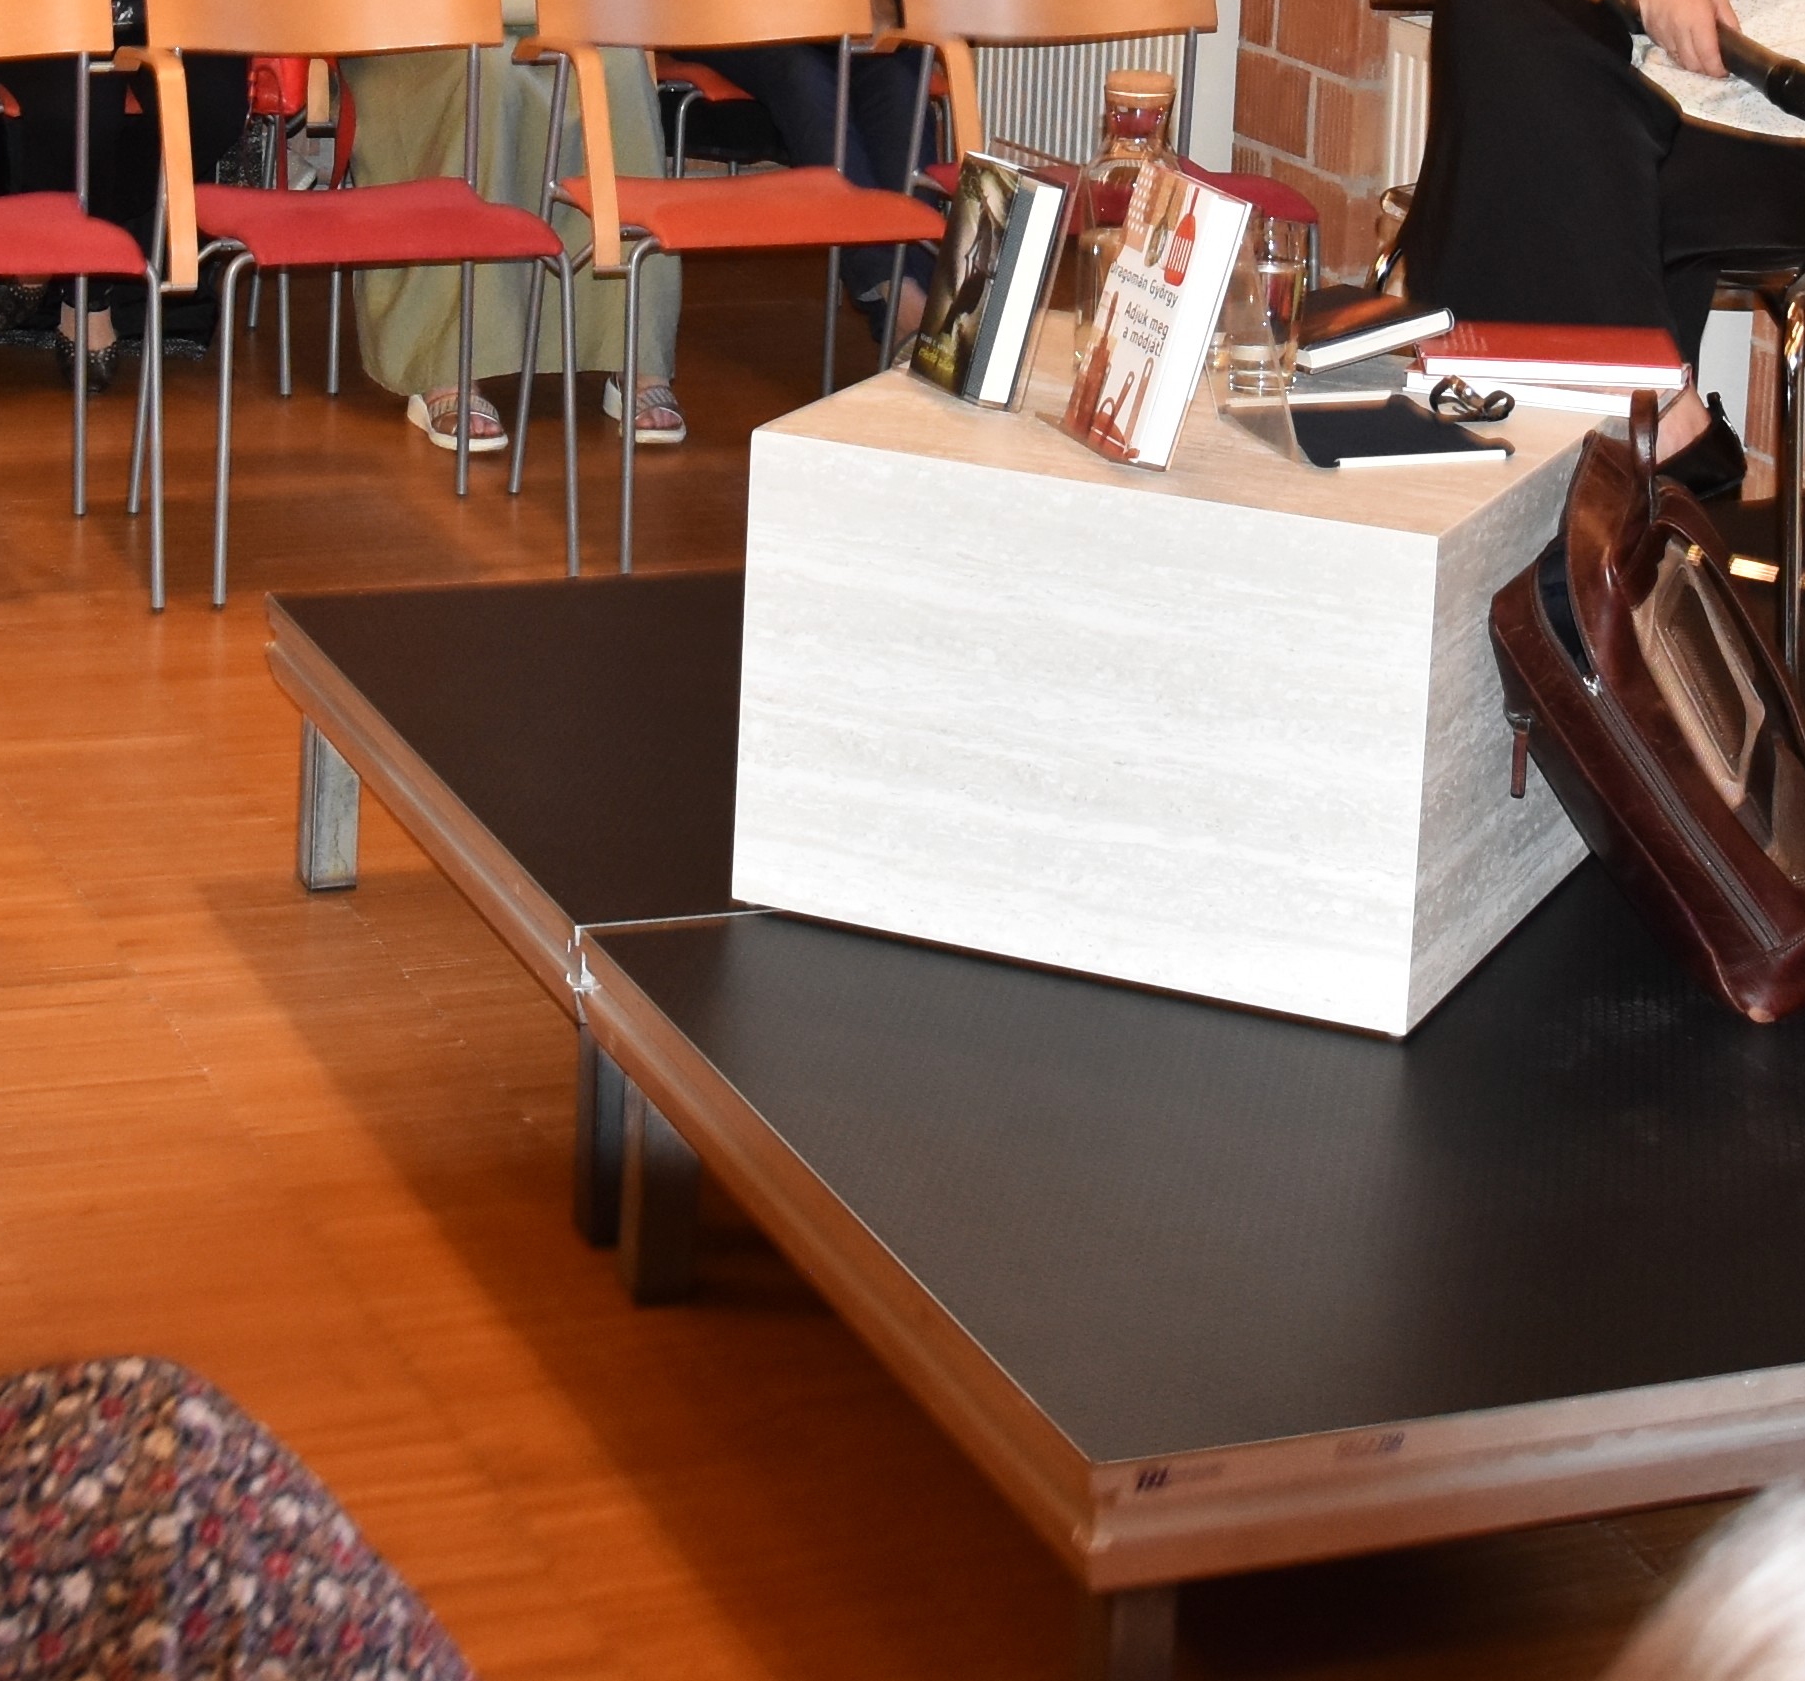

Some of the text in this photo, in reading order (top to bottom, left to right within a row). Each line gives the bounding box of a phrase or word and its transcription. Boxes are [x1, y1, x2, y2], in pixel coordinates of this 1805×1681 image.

[1150, 279, 1179, 308] György
[1122, 326, 1129, 339] a
[1125, 301, 1170, 340] Adjuk meg
